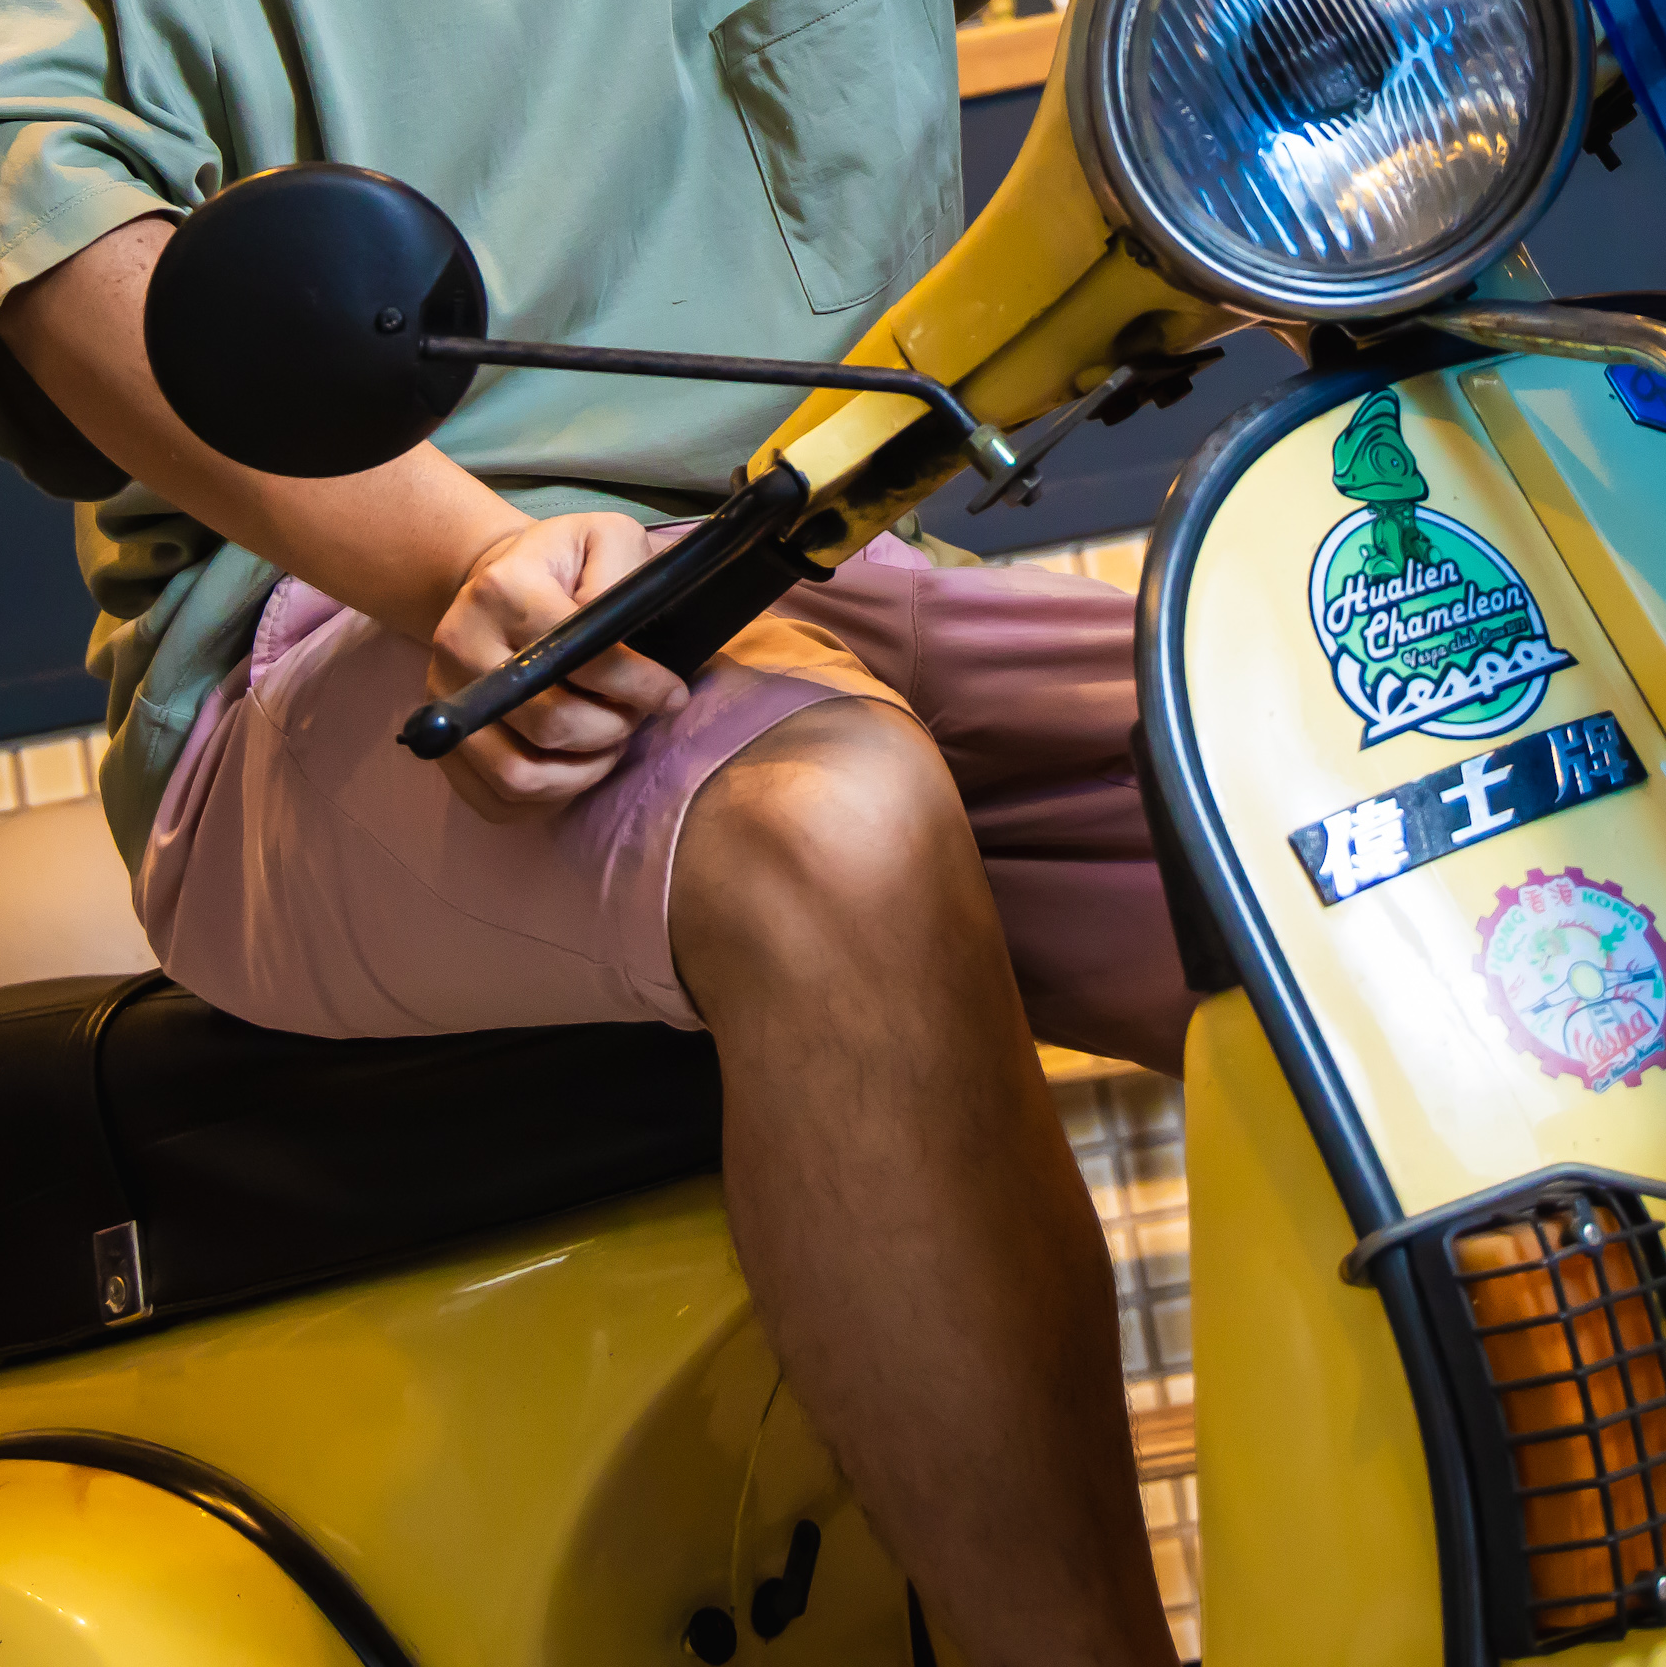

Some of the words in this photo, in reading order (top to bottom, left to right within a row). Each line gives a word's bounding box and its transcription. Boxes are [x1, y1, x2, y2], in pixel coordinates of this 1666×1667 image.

[1327, 558, 1460, 634] Hualien
[1364, 583, 1524, 659] Chameleon
[1337, 638, 1570, 740] Vespa
[1319, 724, 1630, 899] 偉士牌
[1582, 890, 1646, 932] KONG
